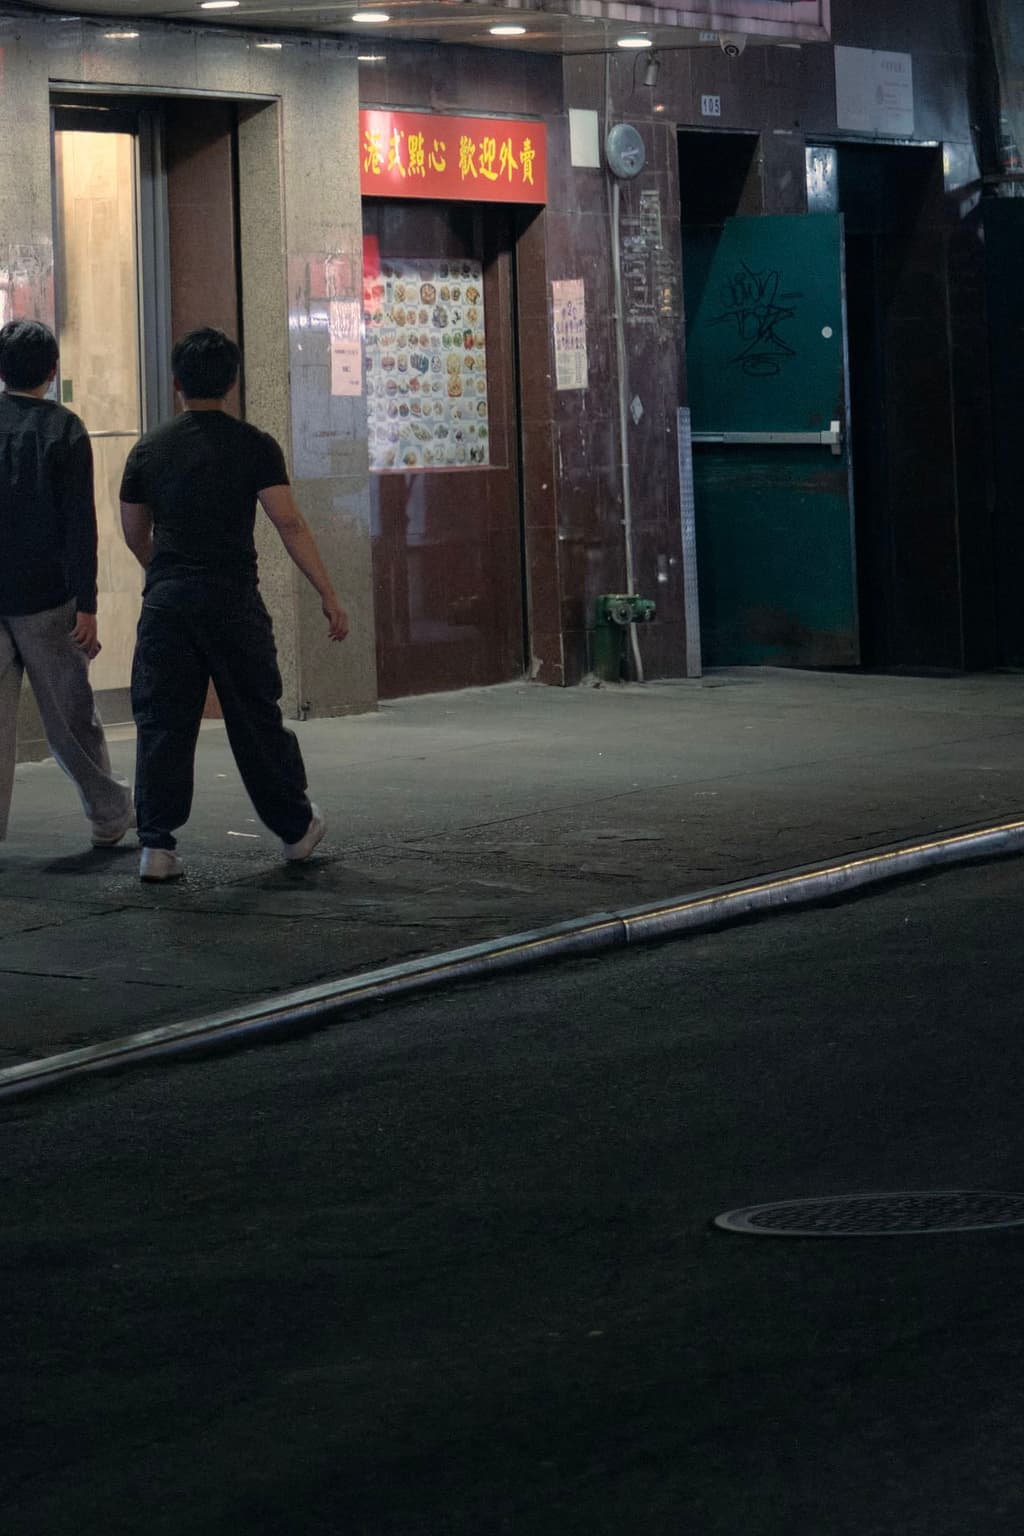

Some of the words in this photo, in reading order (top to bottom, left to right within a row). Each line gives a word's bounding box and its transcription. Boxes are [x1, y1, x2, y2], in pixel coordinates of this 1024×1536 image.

[363, 127, 446, 178] 港式點心
[459, 135, 536, 186] 歡迎外賣
